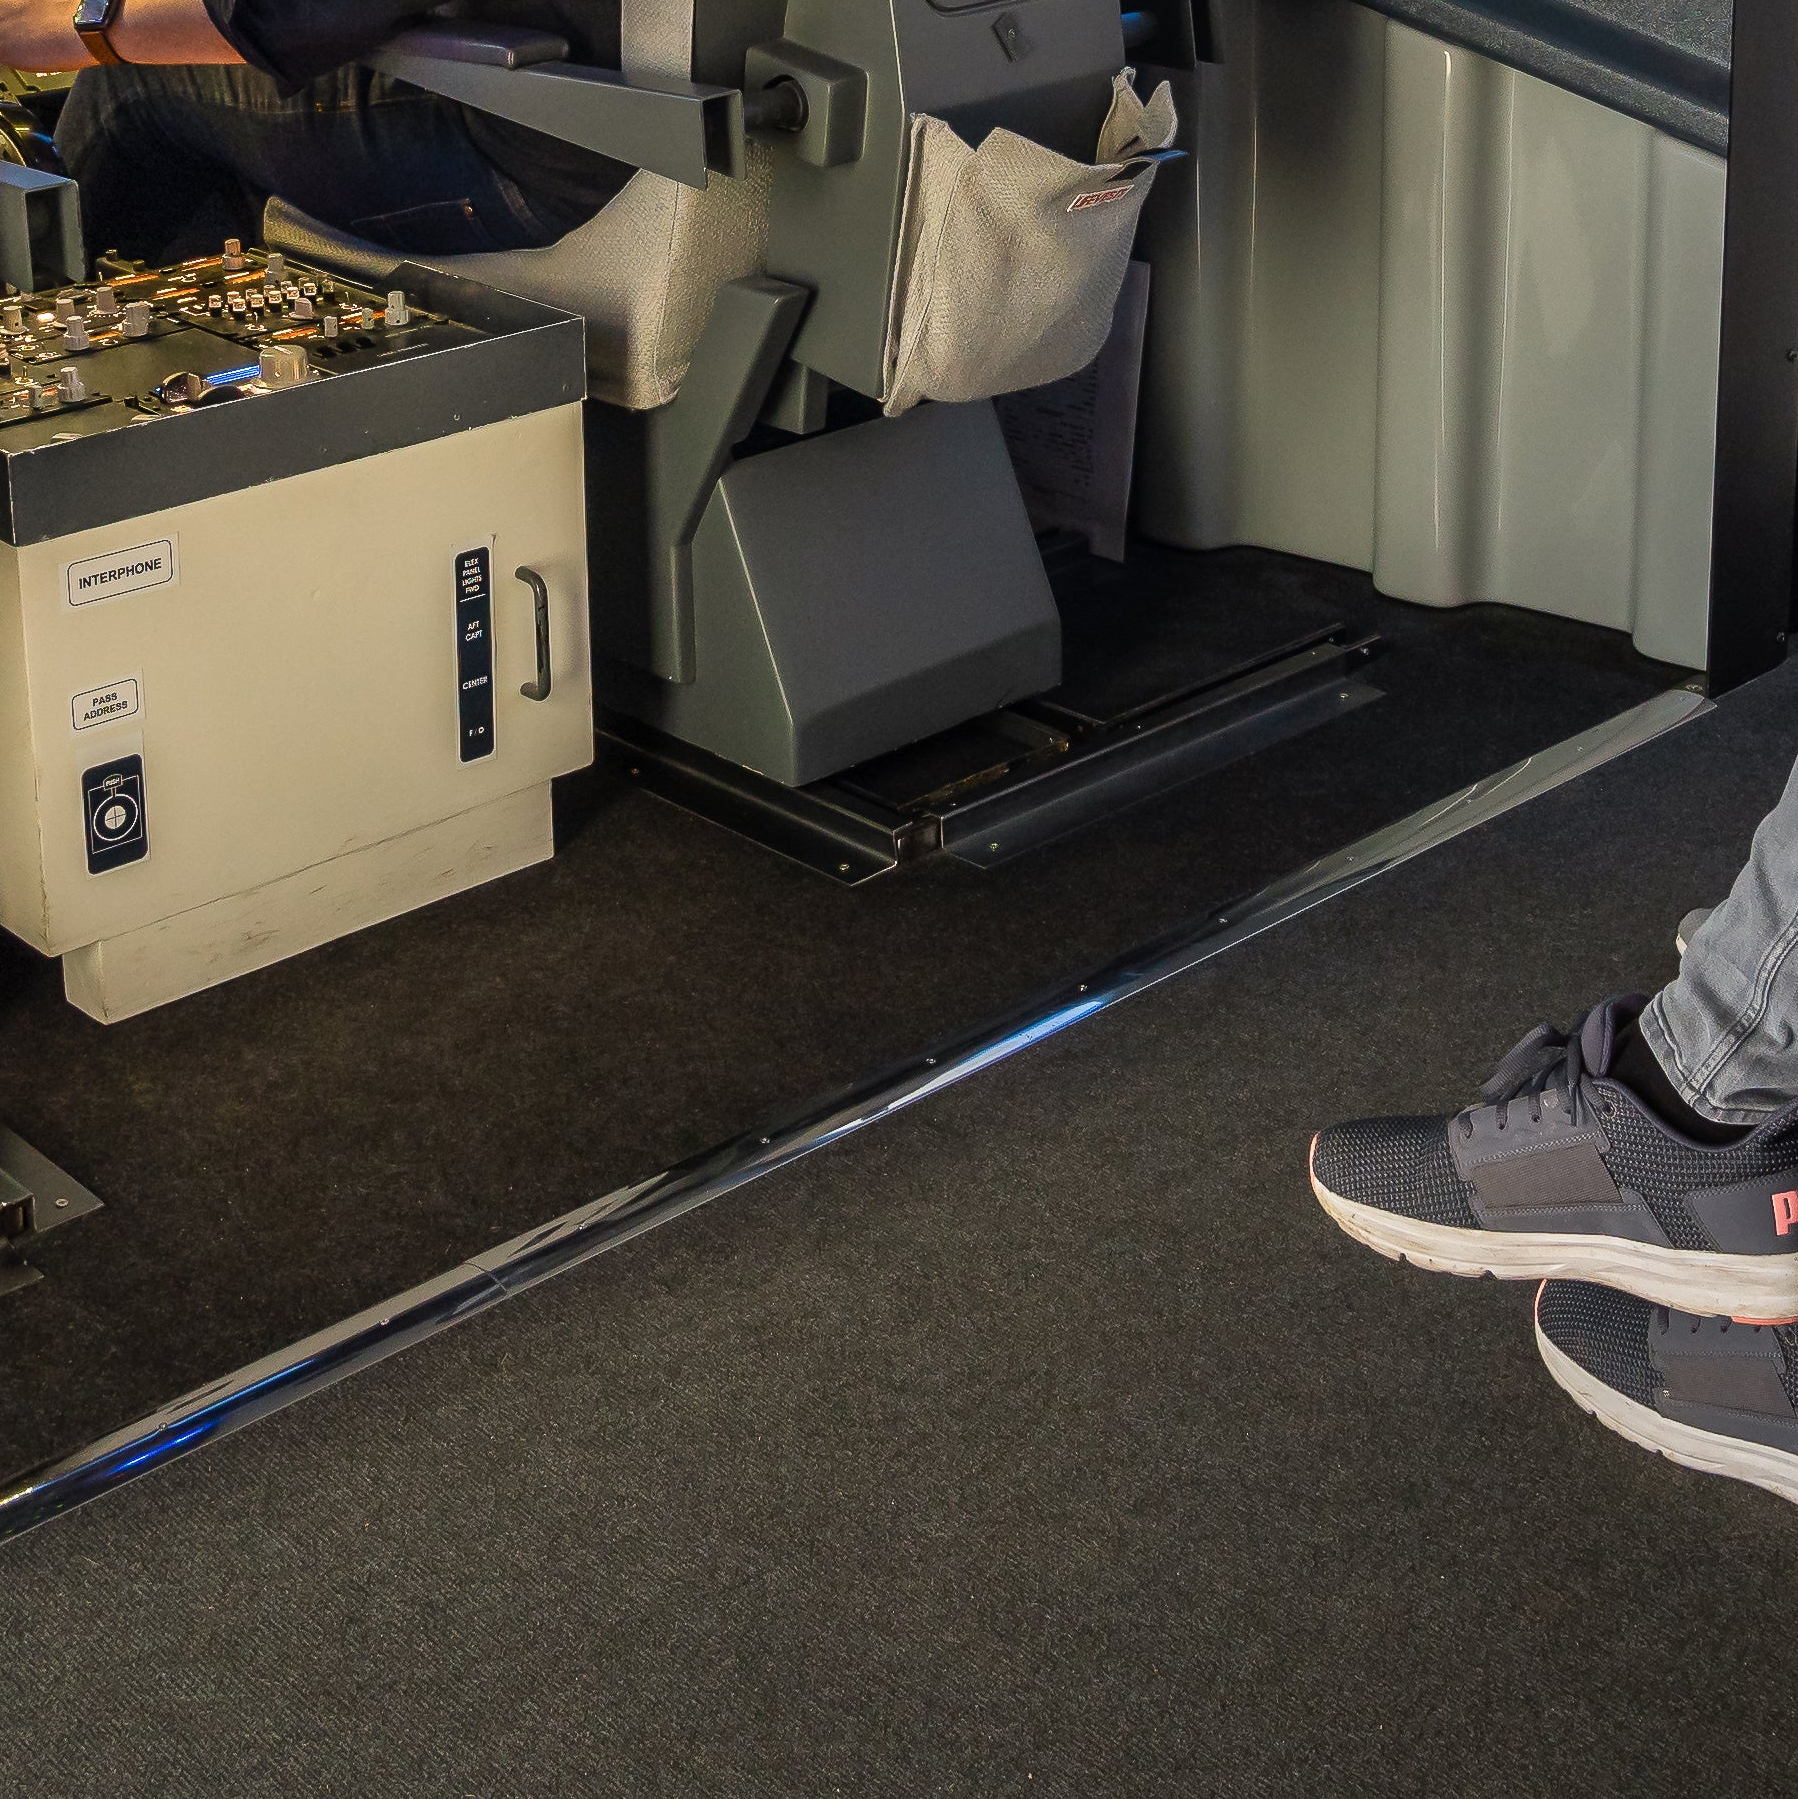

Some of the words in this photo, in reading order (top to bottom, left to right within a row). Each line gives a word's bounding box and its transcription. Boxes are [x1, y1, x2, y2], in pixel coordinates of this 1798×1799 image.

[78, 557, 162, 590] INTERPHONE
[462, 566, 481, 577] PANEL
[461, 574, 483, 587] LIGHTS
[467, 620, 480, 631] AFT
[465, 629, 483, 642] CAPT
[462, 675, 488, 690] CENTER
[92, 692, 118, 707] PASS
[83, 700, 128, 721] ADDRESS
